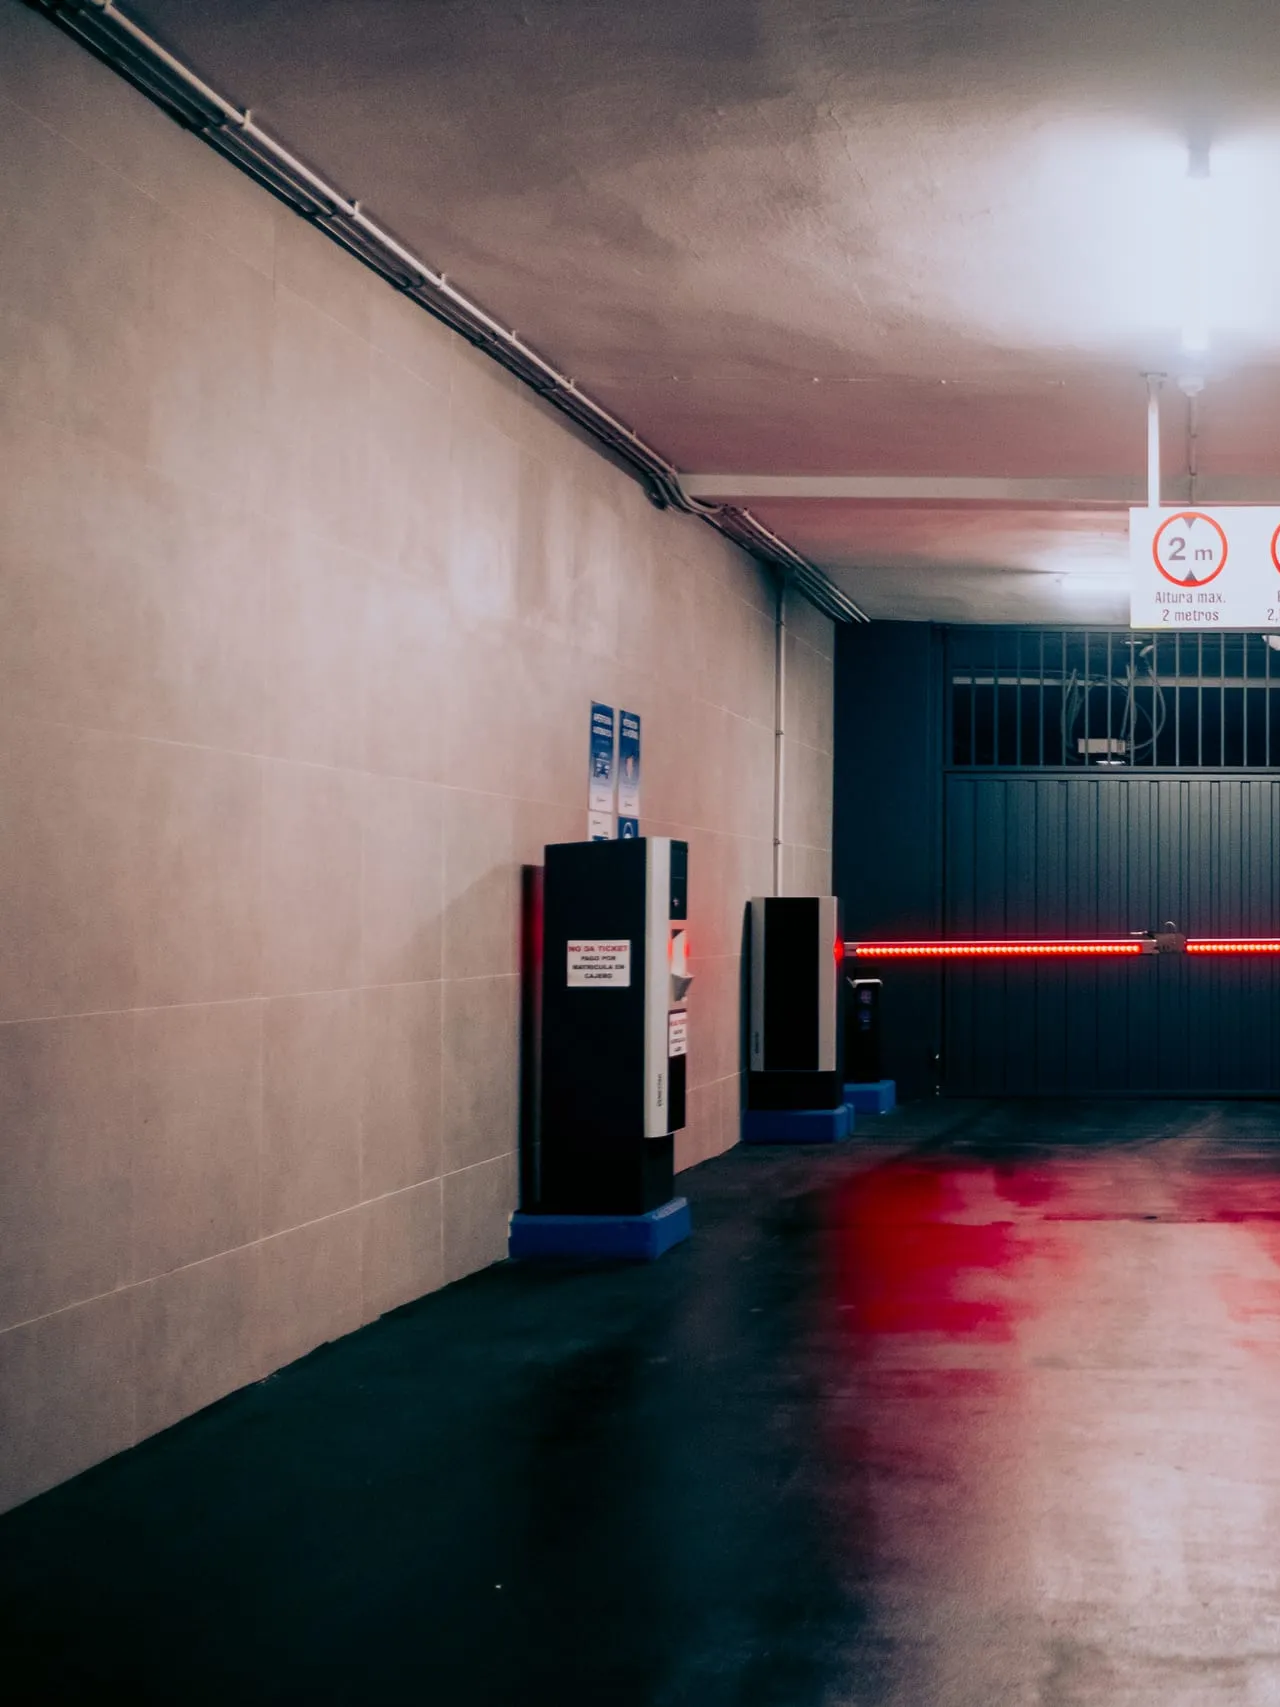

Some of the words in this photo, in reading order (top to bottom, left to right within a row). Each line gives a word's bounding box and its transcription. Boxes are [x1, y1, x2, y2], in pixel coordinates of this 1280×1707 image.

[1168, 536, 1186, 561] 2
[1194, 547, 1213, 561] m
[1155, 591, 1193, 603] Altura
[1197, 592, 1226, 603] max.
[1162, 608, 1170, 622] 2
[1174, 609, 1219, 621] metros
